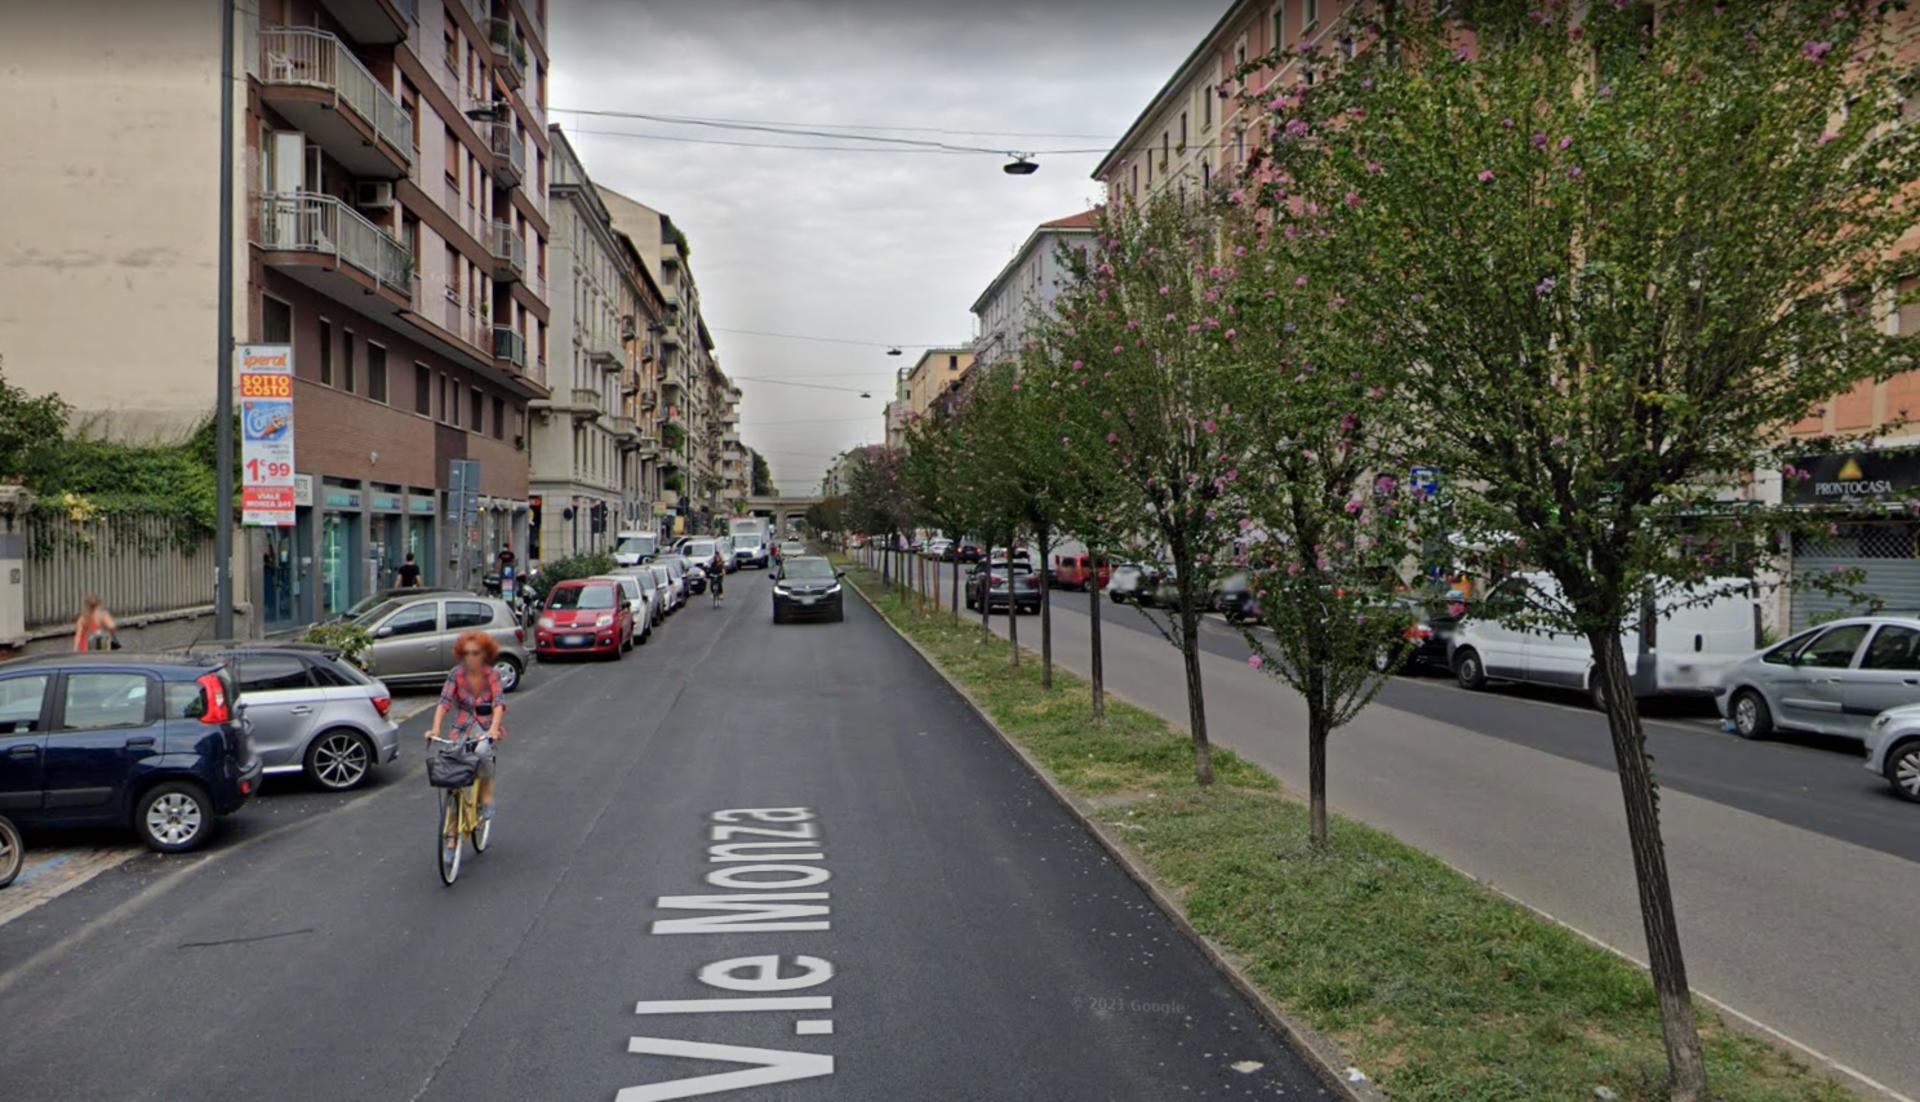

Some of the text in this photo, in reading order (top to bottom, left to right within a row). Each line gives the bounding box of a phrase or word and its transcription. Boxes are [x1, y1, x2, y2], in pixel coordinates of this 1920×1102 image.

[243, 375, 290, 386] SOTTO
[244, 386, 290, 396] COSTO
[1815, 480, 1892, 495] PRONTOCASA
[615, 807, 834, 1102] V.le Monza
